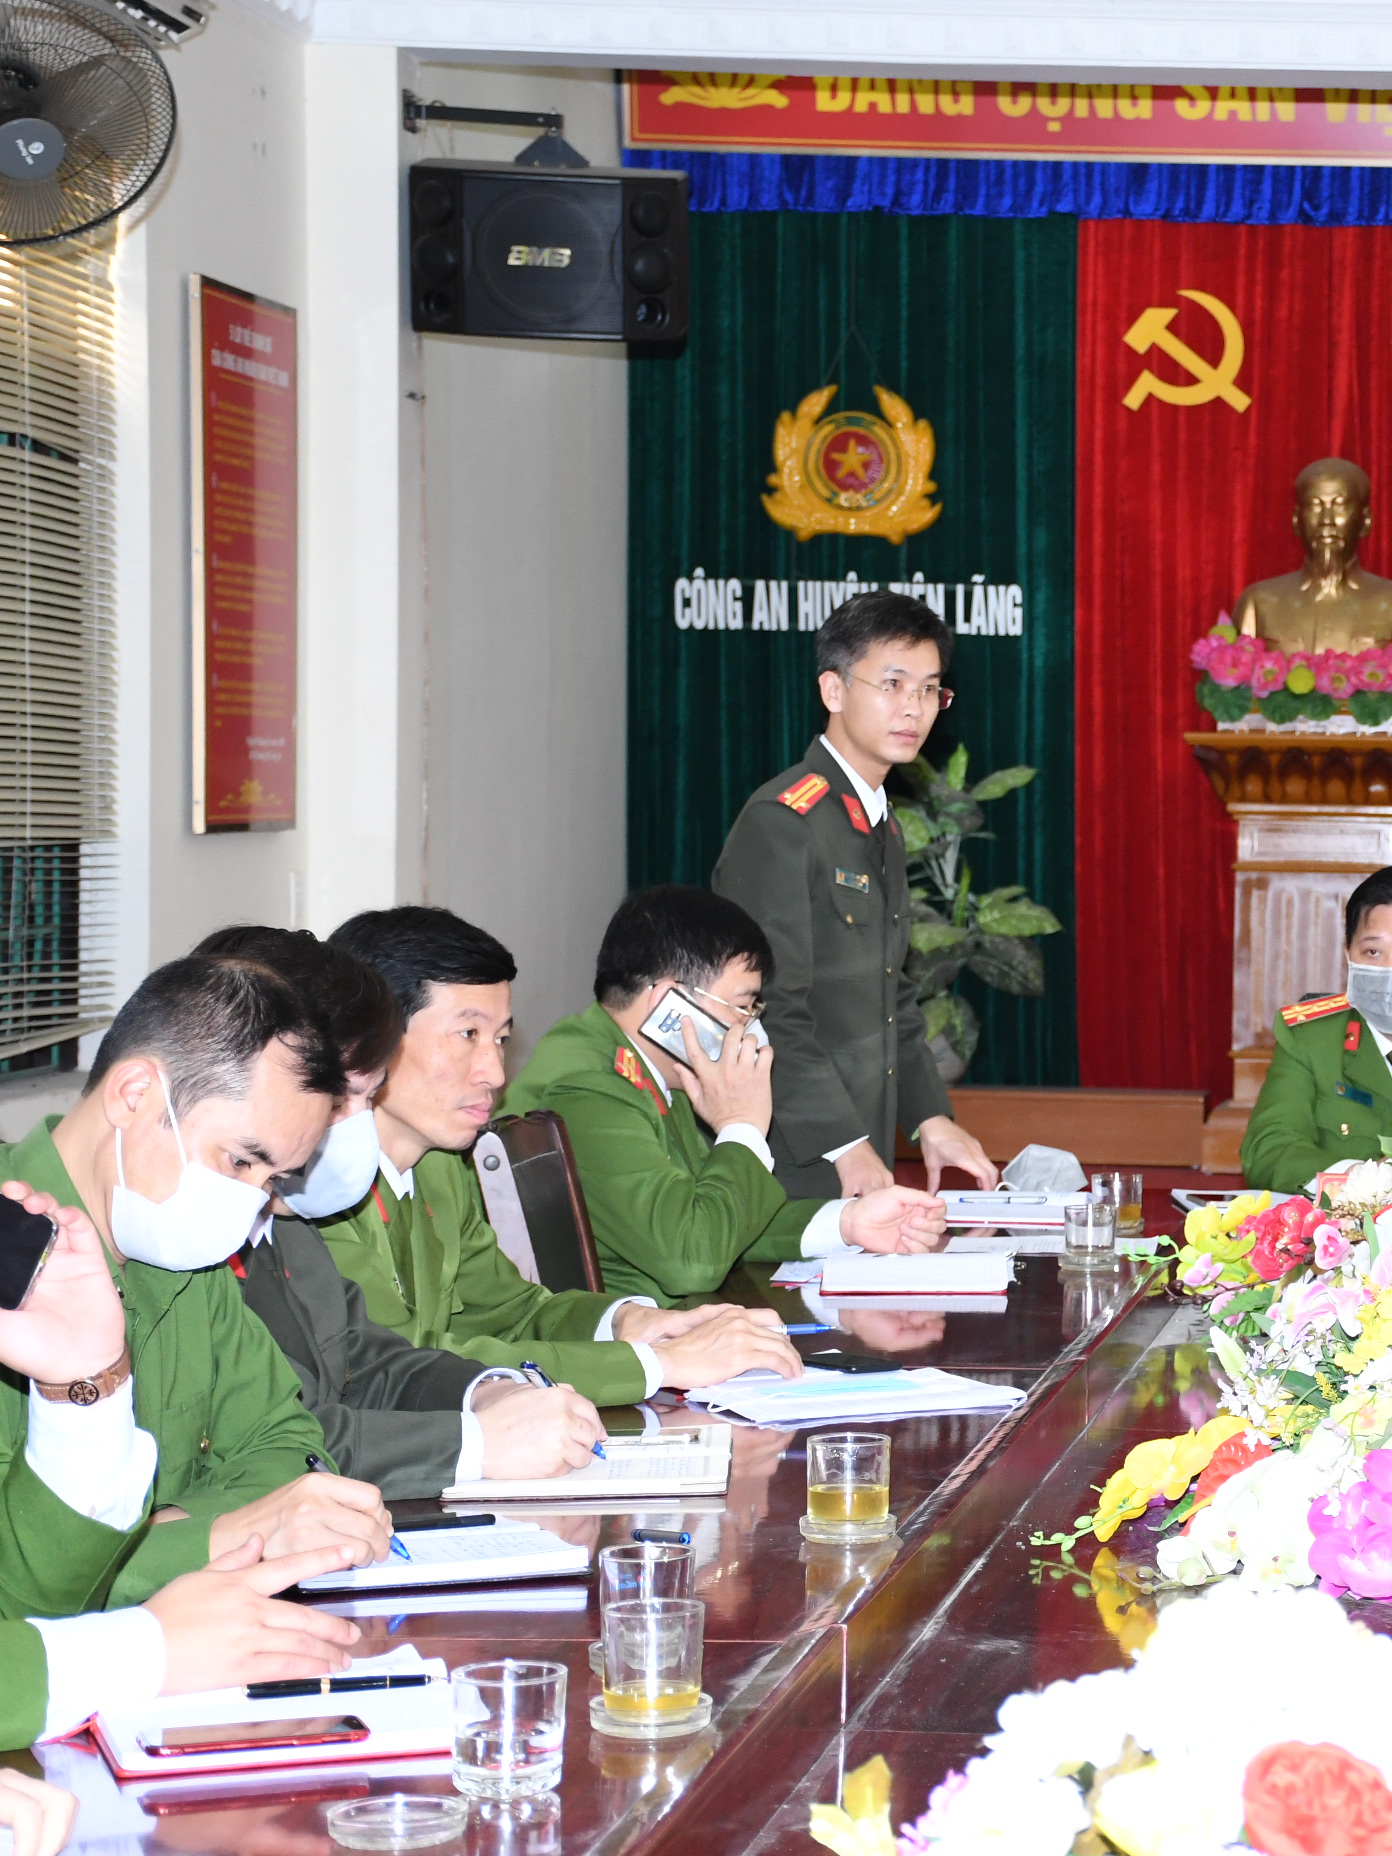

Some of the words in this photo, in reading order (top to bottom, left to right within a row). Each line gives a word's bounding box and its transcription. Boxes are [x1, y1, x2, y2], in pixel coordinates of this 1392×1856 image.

[508, 244, 572, 268] BMB
[673, 566, 744, 631] CÔNG
[751, 578, 790, 632] AN
[796, 570, 879, 632] HUY
[955, 572, 1024, 637] LÃNG
